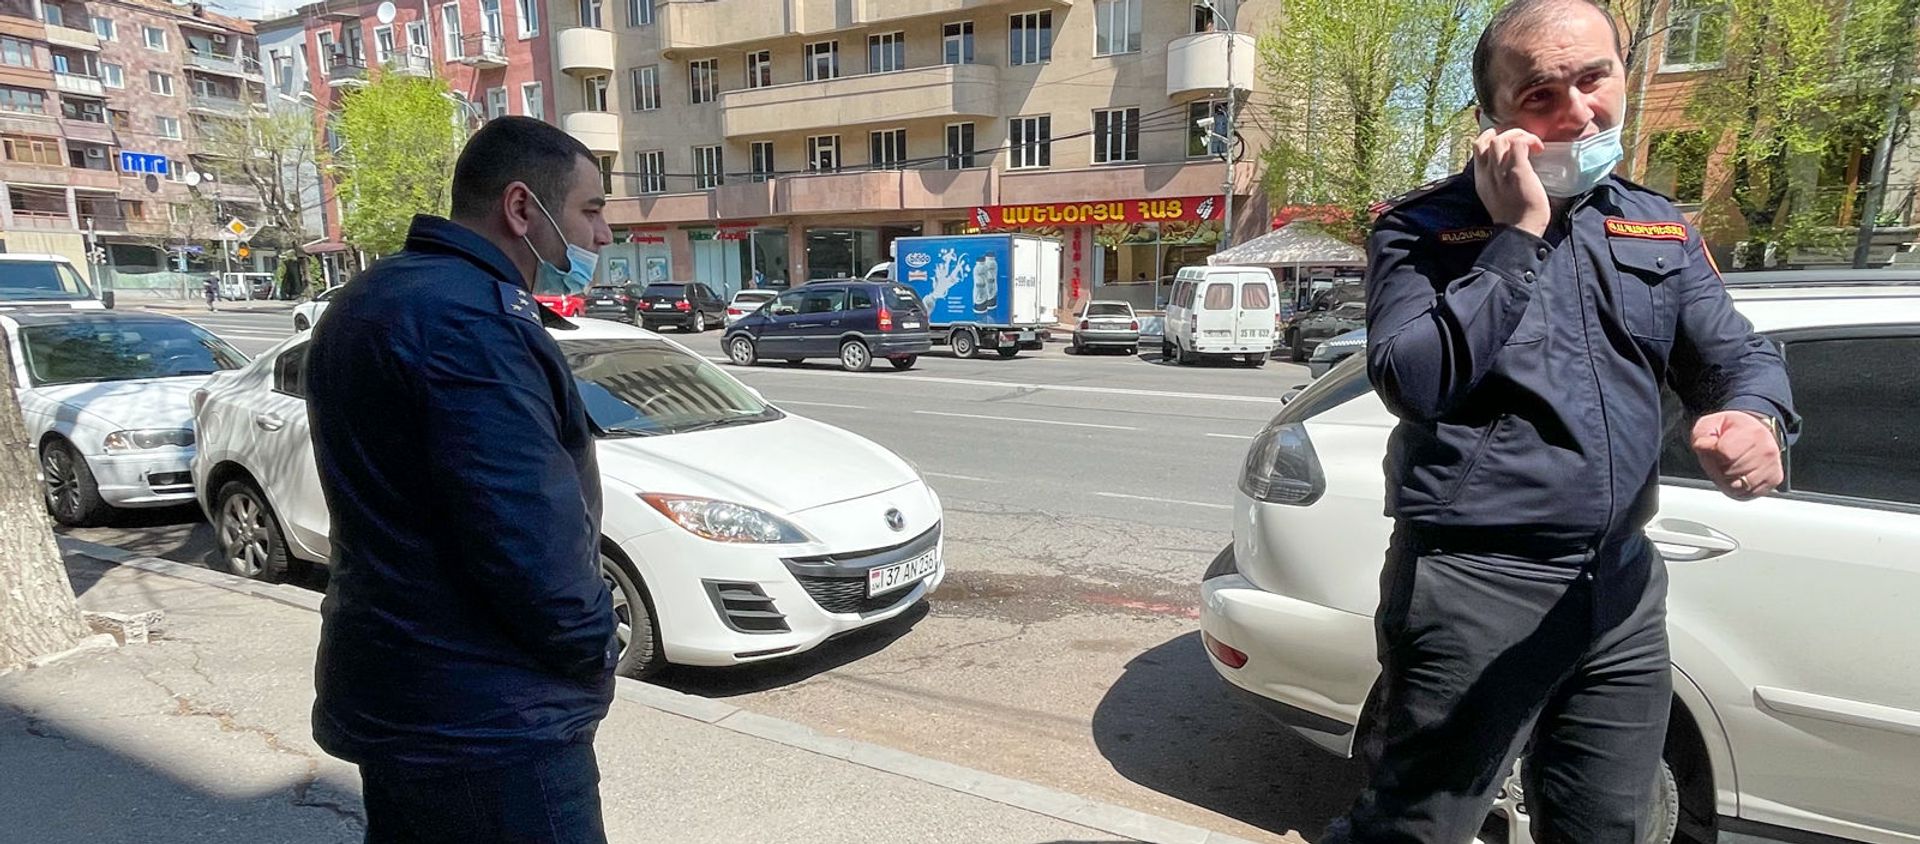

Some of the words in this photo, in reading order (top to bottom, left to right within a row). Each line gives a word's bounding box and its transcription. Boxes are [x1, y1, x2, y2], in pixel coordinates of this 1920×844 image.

[1001, 202, 1125, 225] ԱՄԵՆՕՐՅԱ
[1137, 199, 1184, 220] ՀԱՑ
[886, 566, 900, 587] 37
[903, 560, 918, 582] AN
